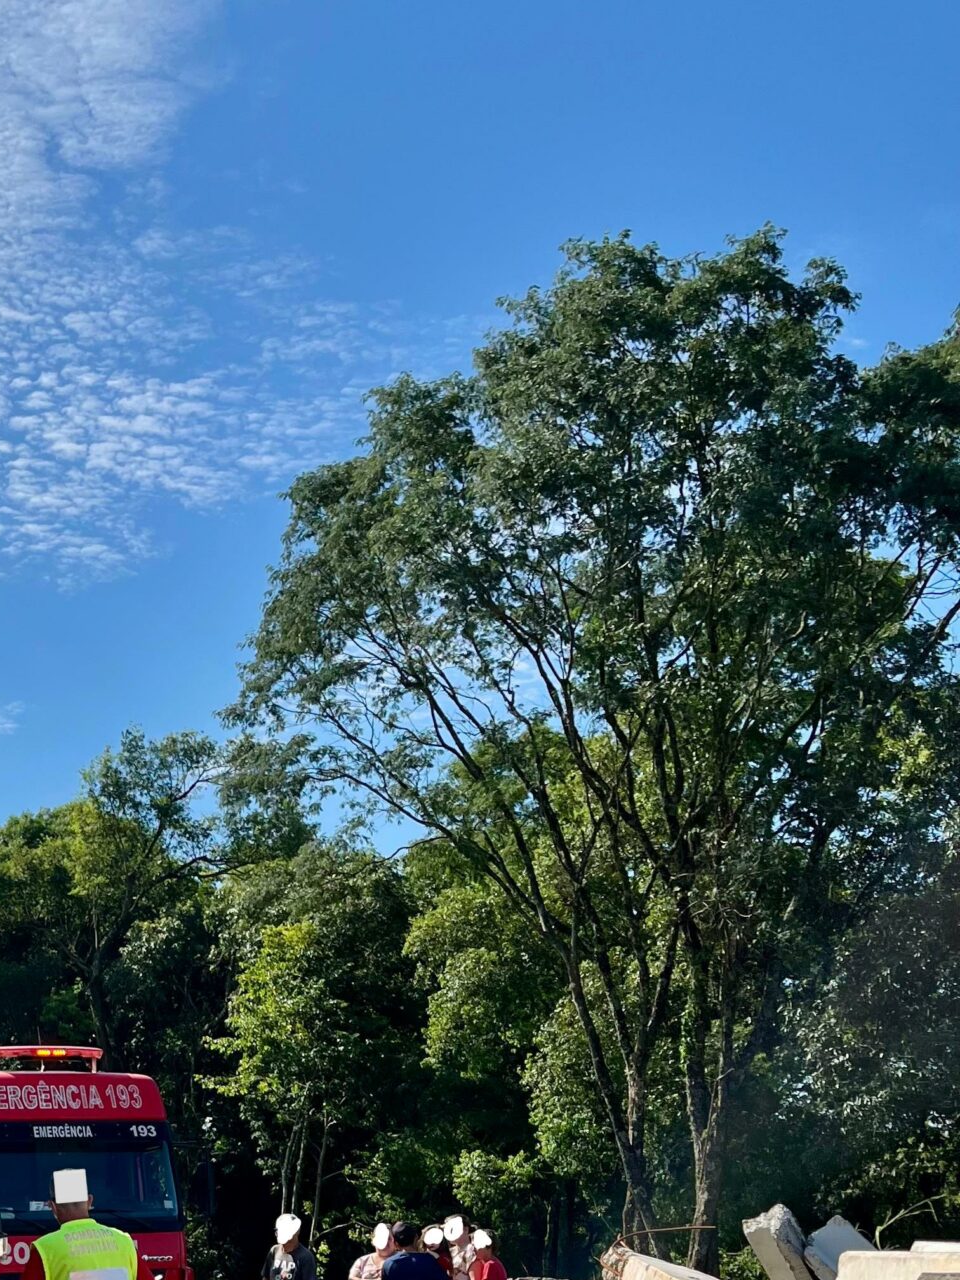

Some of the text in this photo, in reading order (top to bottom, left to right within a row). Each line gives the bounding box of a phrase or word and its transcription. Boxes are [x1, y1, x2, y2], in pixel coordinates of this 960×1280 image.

[105, 1084, 142, 1108] 193
[33, 1123, 157, 1138] EMERGÊNCIA 193
